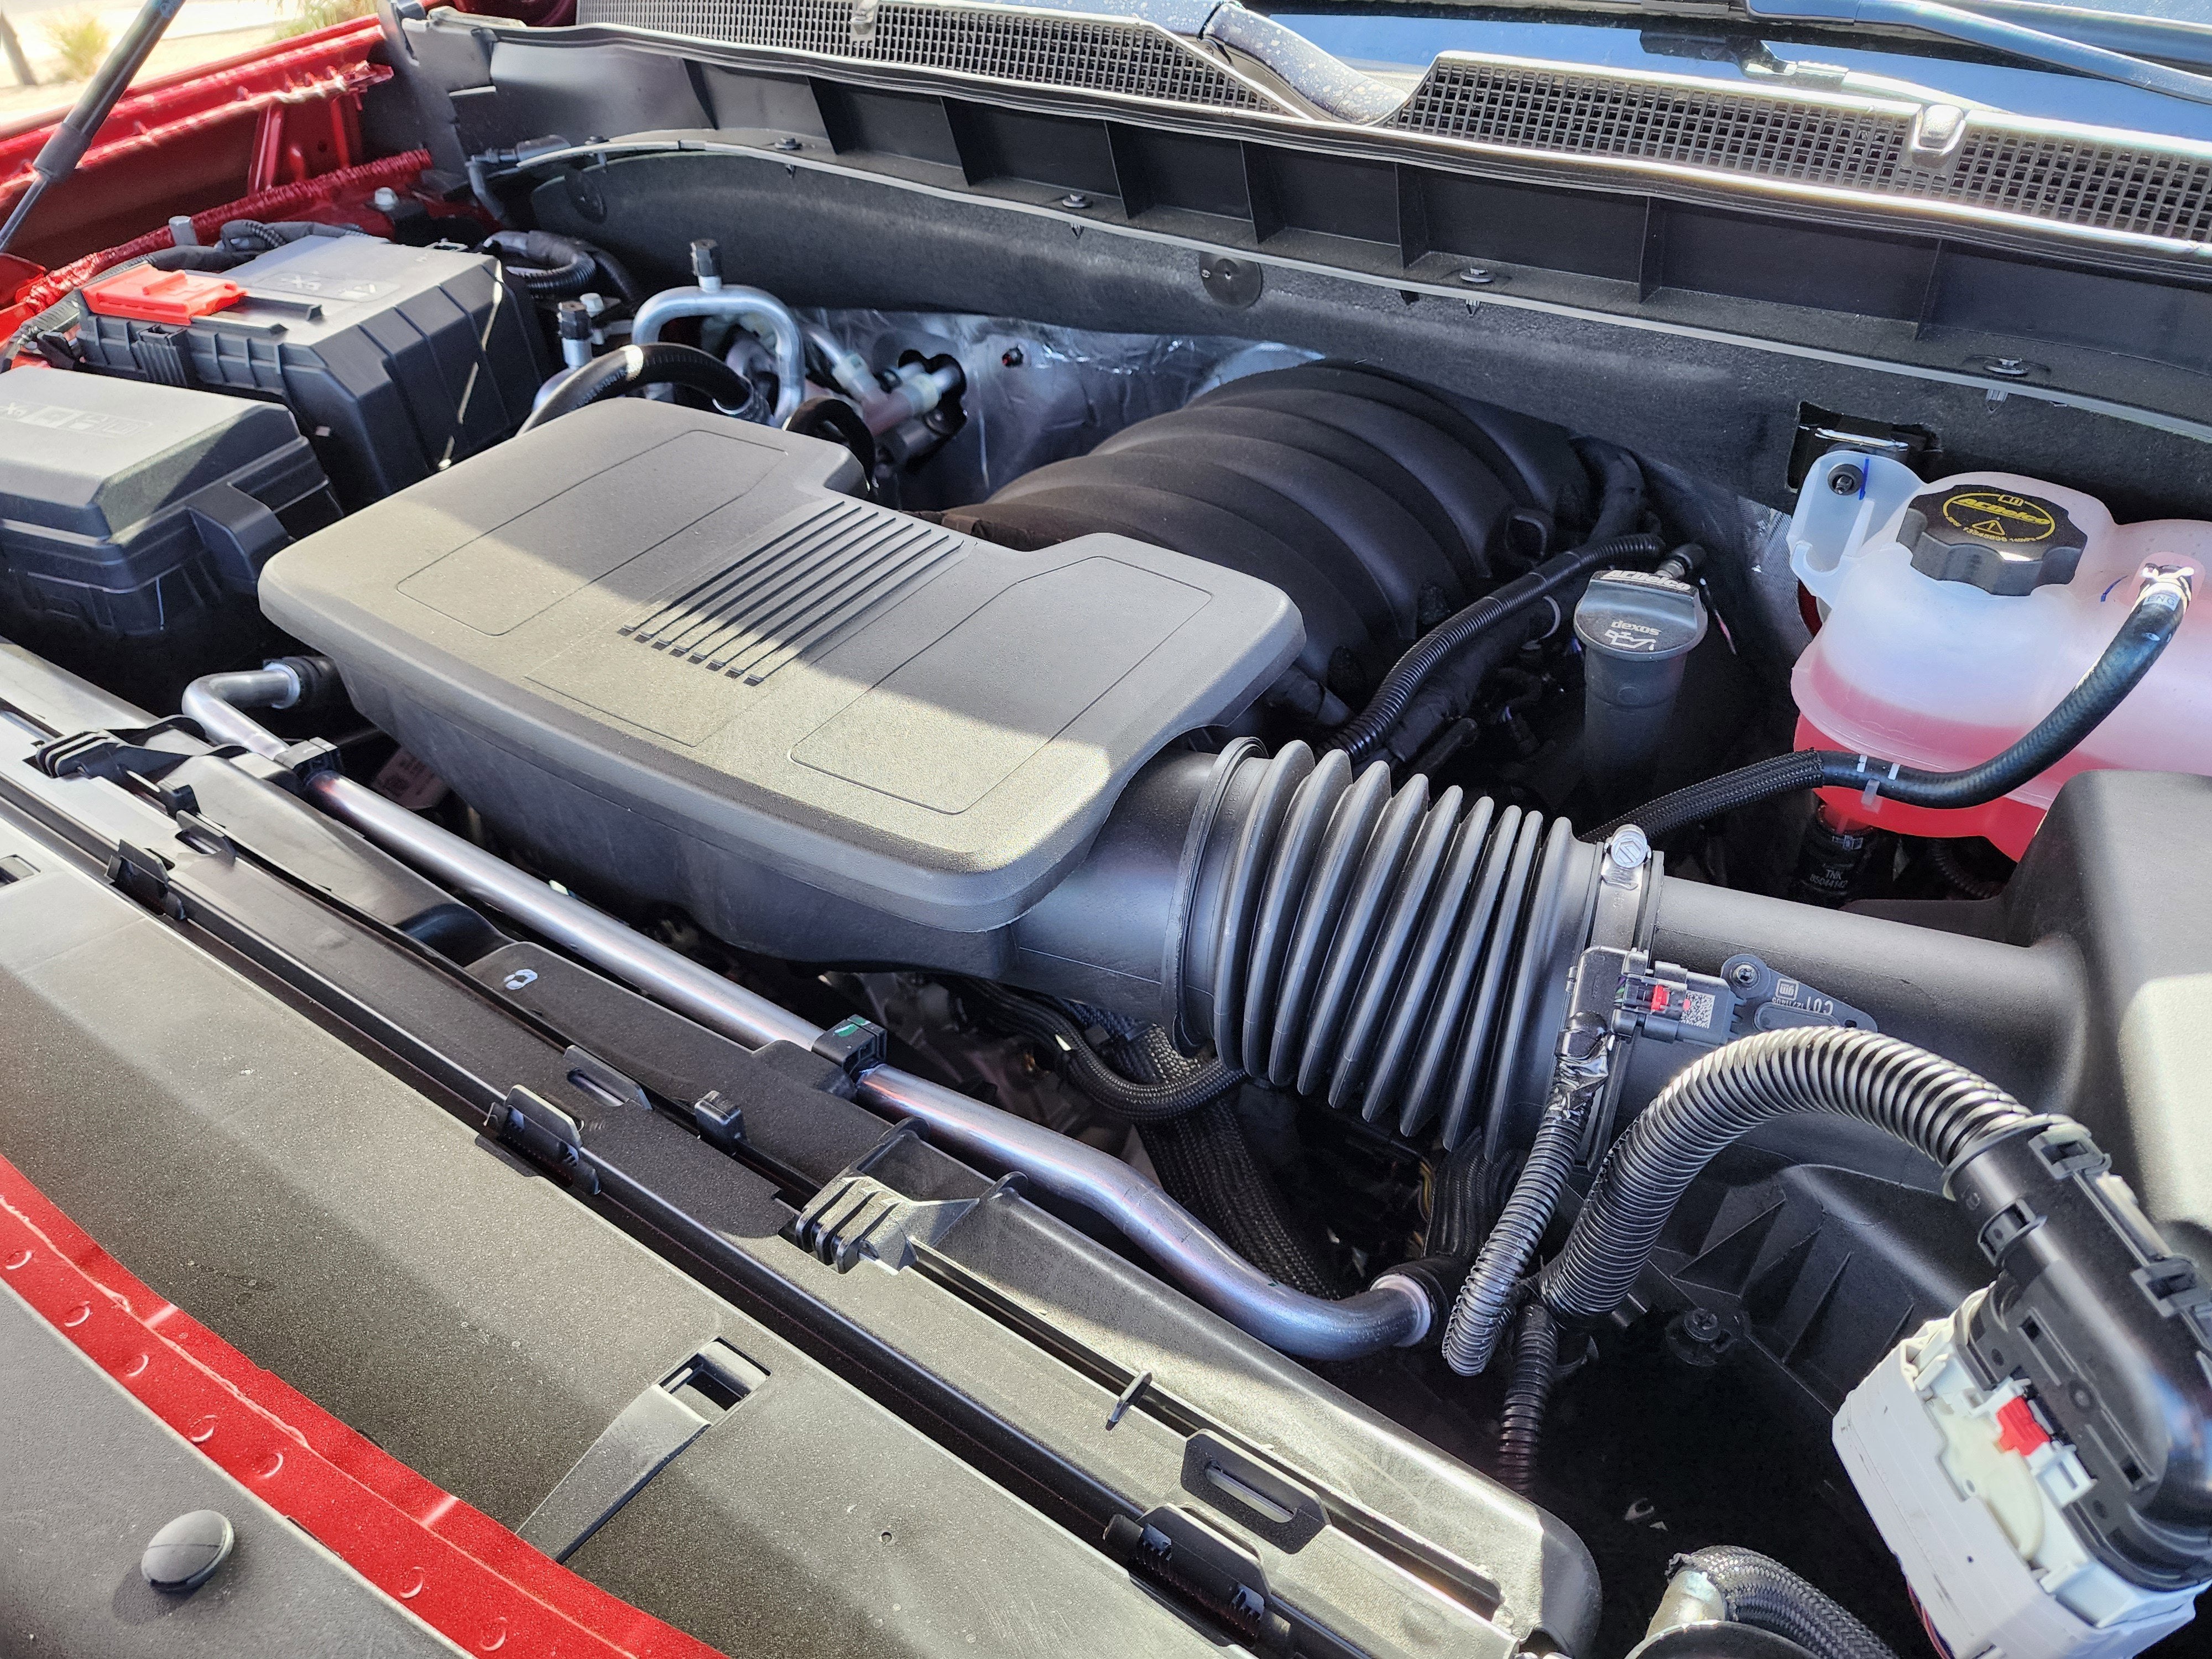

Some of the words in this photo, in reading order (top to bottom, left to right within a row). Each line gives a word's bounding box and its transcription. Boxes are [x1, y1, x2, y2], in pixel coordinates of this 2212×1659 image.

[1957, 498, 2051, 525] ACDelco
[1602, 570, 1691, 591] ACDelco
[2146, 594, 2176, 606] ENG
[1610, 620, 1662, 637] dexos
